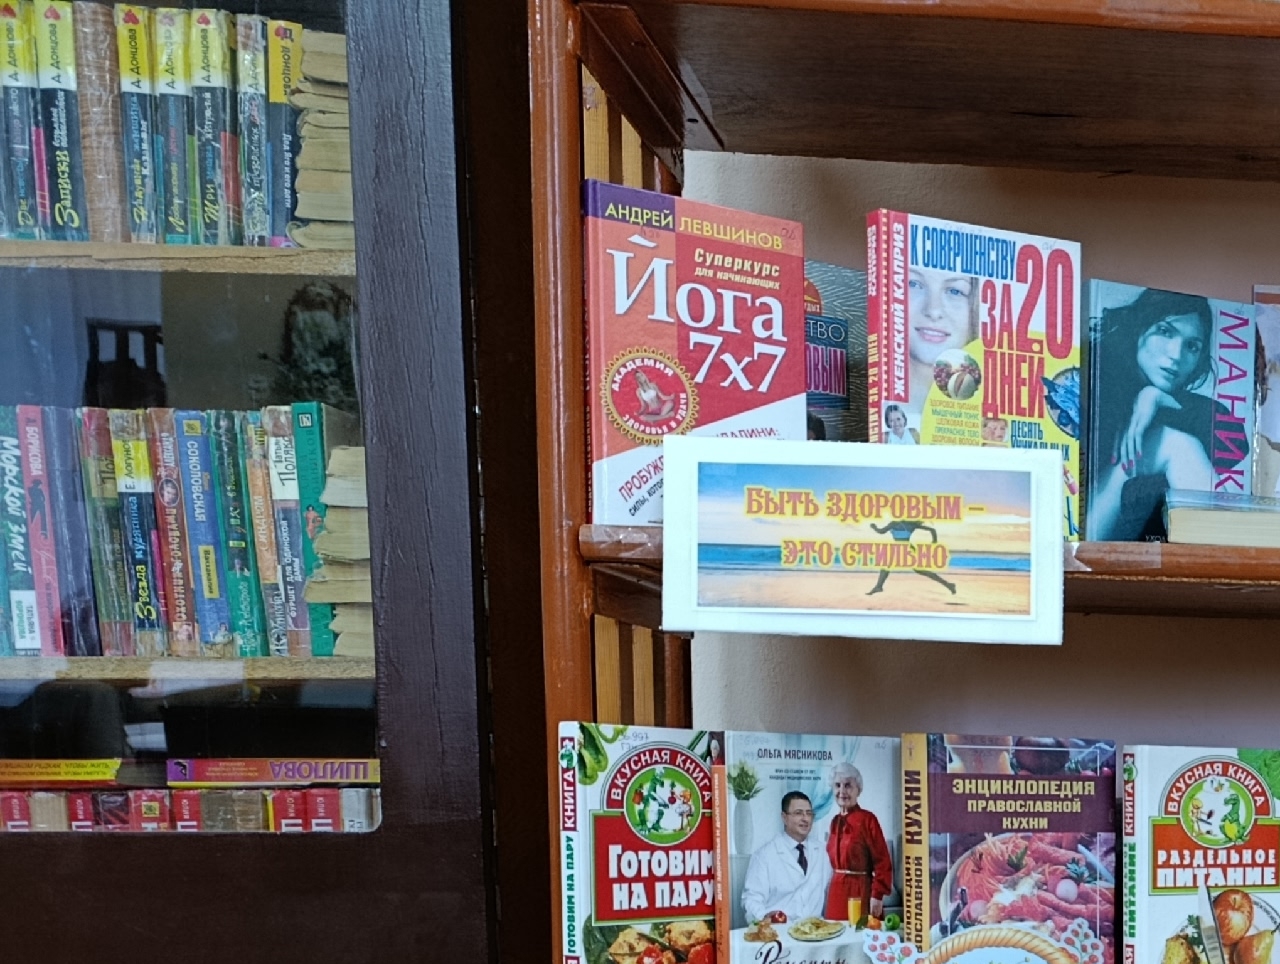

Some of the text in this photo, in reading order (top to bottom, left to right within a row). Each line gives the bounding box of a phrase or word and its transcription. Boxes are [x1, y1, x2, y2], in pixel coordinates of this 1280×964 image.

[128, 28, 141, 76] ДОНЦОВА
[54, 150, 81, 228] Записки
[605, 203, 674, 229] АНДРЕЙ
[679, 217, 783, 250] ЛЕВШИНОВ
[695, 248, 780, 277] Суперкурс
[910, 224, 919, 266] К
[922, 226, 1017, 283] СОВЕРШЕНСТВУ
[606, 235, 787, 342] Йога
[892, 222, 905, 398] ЖЕНСКИЙ КАПРИЗ
[981, 243, 1075, 360] ЗА 20
[981, 347, 1045, 421] ДНЕЙ
[26, 427, 43, 476] БОРИСОВА
[1011, 420, 1043, 441] ДЕСЯТЬ
[0, 436, 32, 575] Морской змей
[187, 441, 207, 523] СОКОЛОВСКАЯ
[827, 492, 961, 521] ЗДОРОВЫМ
[281, 520, 297, 617] ФУРШЕТ ДЛЯ ОДИНОКОЙ
[783, 541, 948, 569] ЭТО СТИЛЬНО
[136, 564, 157, 620] Звезда
[269, 760, 369, 780] ШИЛОВА
[611, 750, 712, 803] ВКУСНАЯ КНИГА
[757, 748, 833, 761] ОЛЬГА МЯСНИКОВА
[562, 770, 577, 829] КНИГА
[905, 770, 923, 845] КУХНИ
[952, 778, 1095, 796] ЭНЦИКЛОПЕДИЯ
[967, 797, 1082, 813] ПРАВОСЛАВНОЙ
[1125, 781, 1135, 835] КНИГА
[1167, 763, 1264, 813] ВКУСНАЯ КНИГА
[1002, 817, 1048, 830] КУХНИ
[1157, 867, 1276, 888] ПИТАНИЕ
[1158, 849, 1276, 866] РАЗДЕЛЬНОЕ
[565, 836, 577, 954] ГОТОВИМ ПАРУ
[613, 882, 648, 911] НА
[1128, 842, 1137, 938] ПИТАНИЕ
